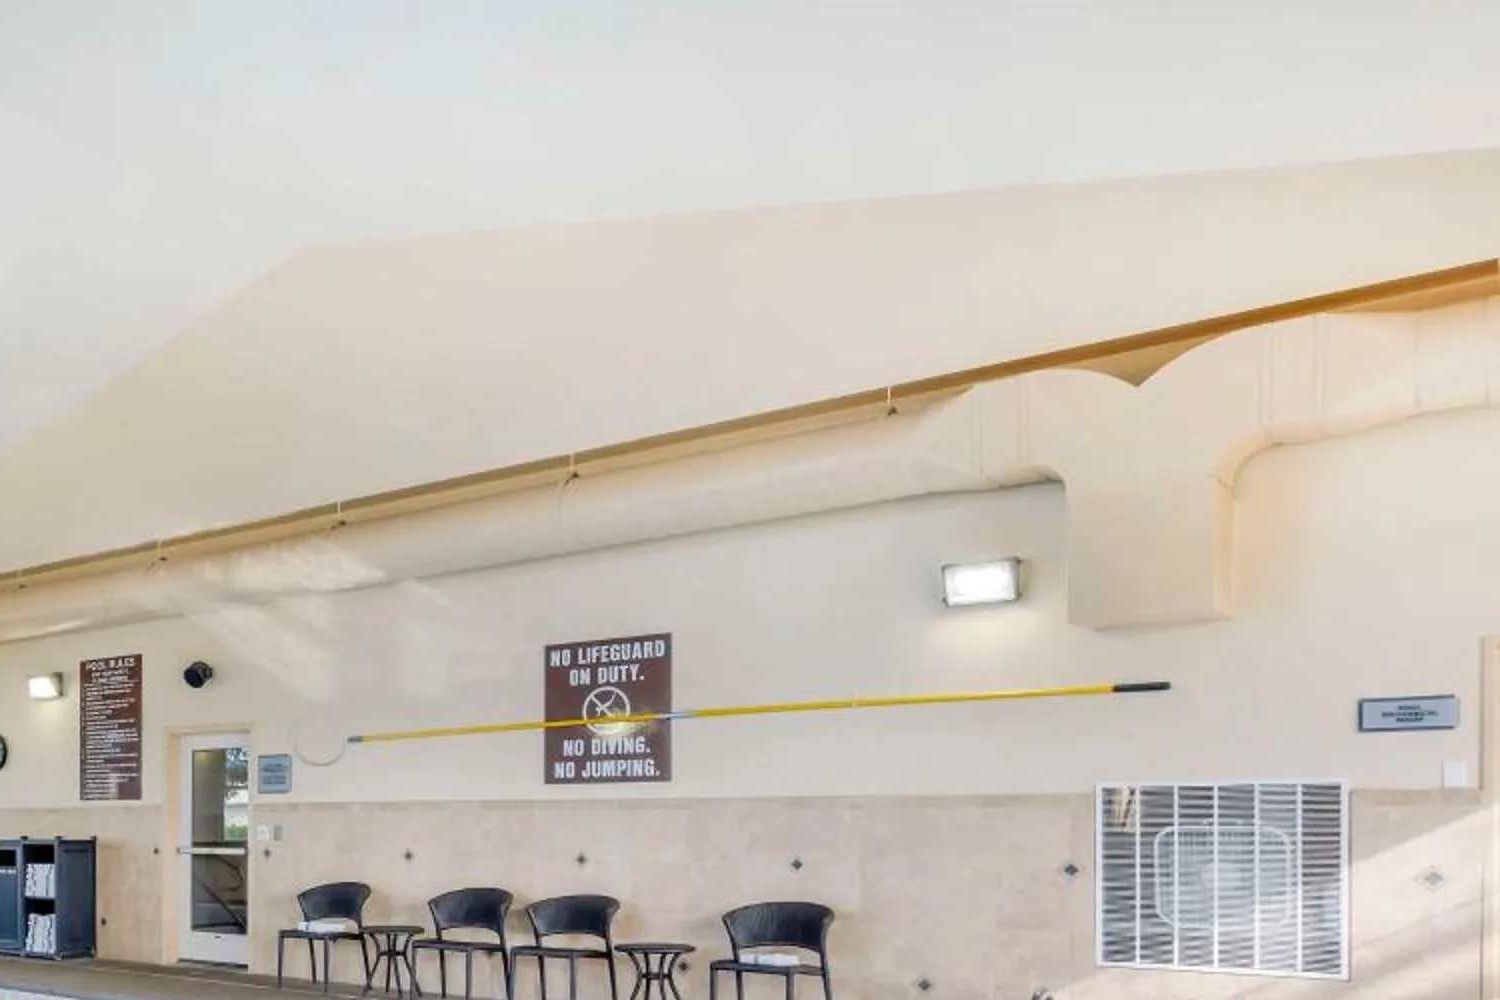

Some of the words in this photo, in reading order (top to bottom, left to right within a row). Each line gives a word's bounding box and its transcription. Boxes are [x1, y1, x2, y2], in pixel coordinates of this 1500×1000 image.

[550, 649, 571, 667] NO
[577, 639, 665, 665] LIFEGUARD
[569, 668, 591, 687] ON
[597, 663, 645, 684] DUTY.
[563, 739, 585, 757] NO
[591, 736, 651, 756] DIVING.
[554, 761, 576, 779] NO
[581, 758, 661, 778] JUMPING.
